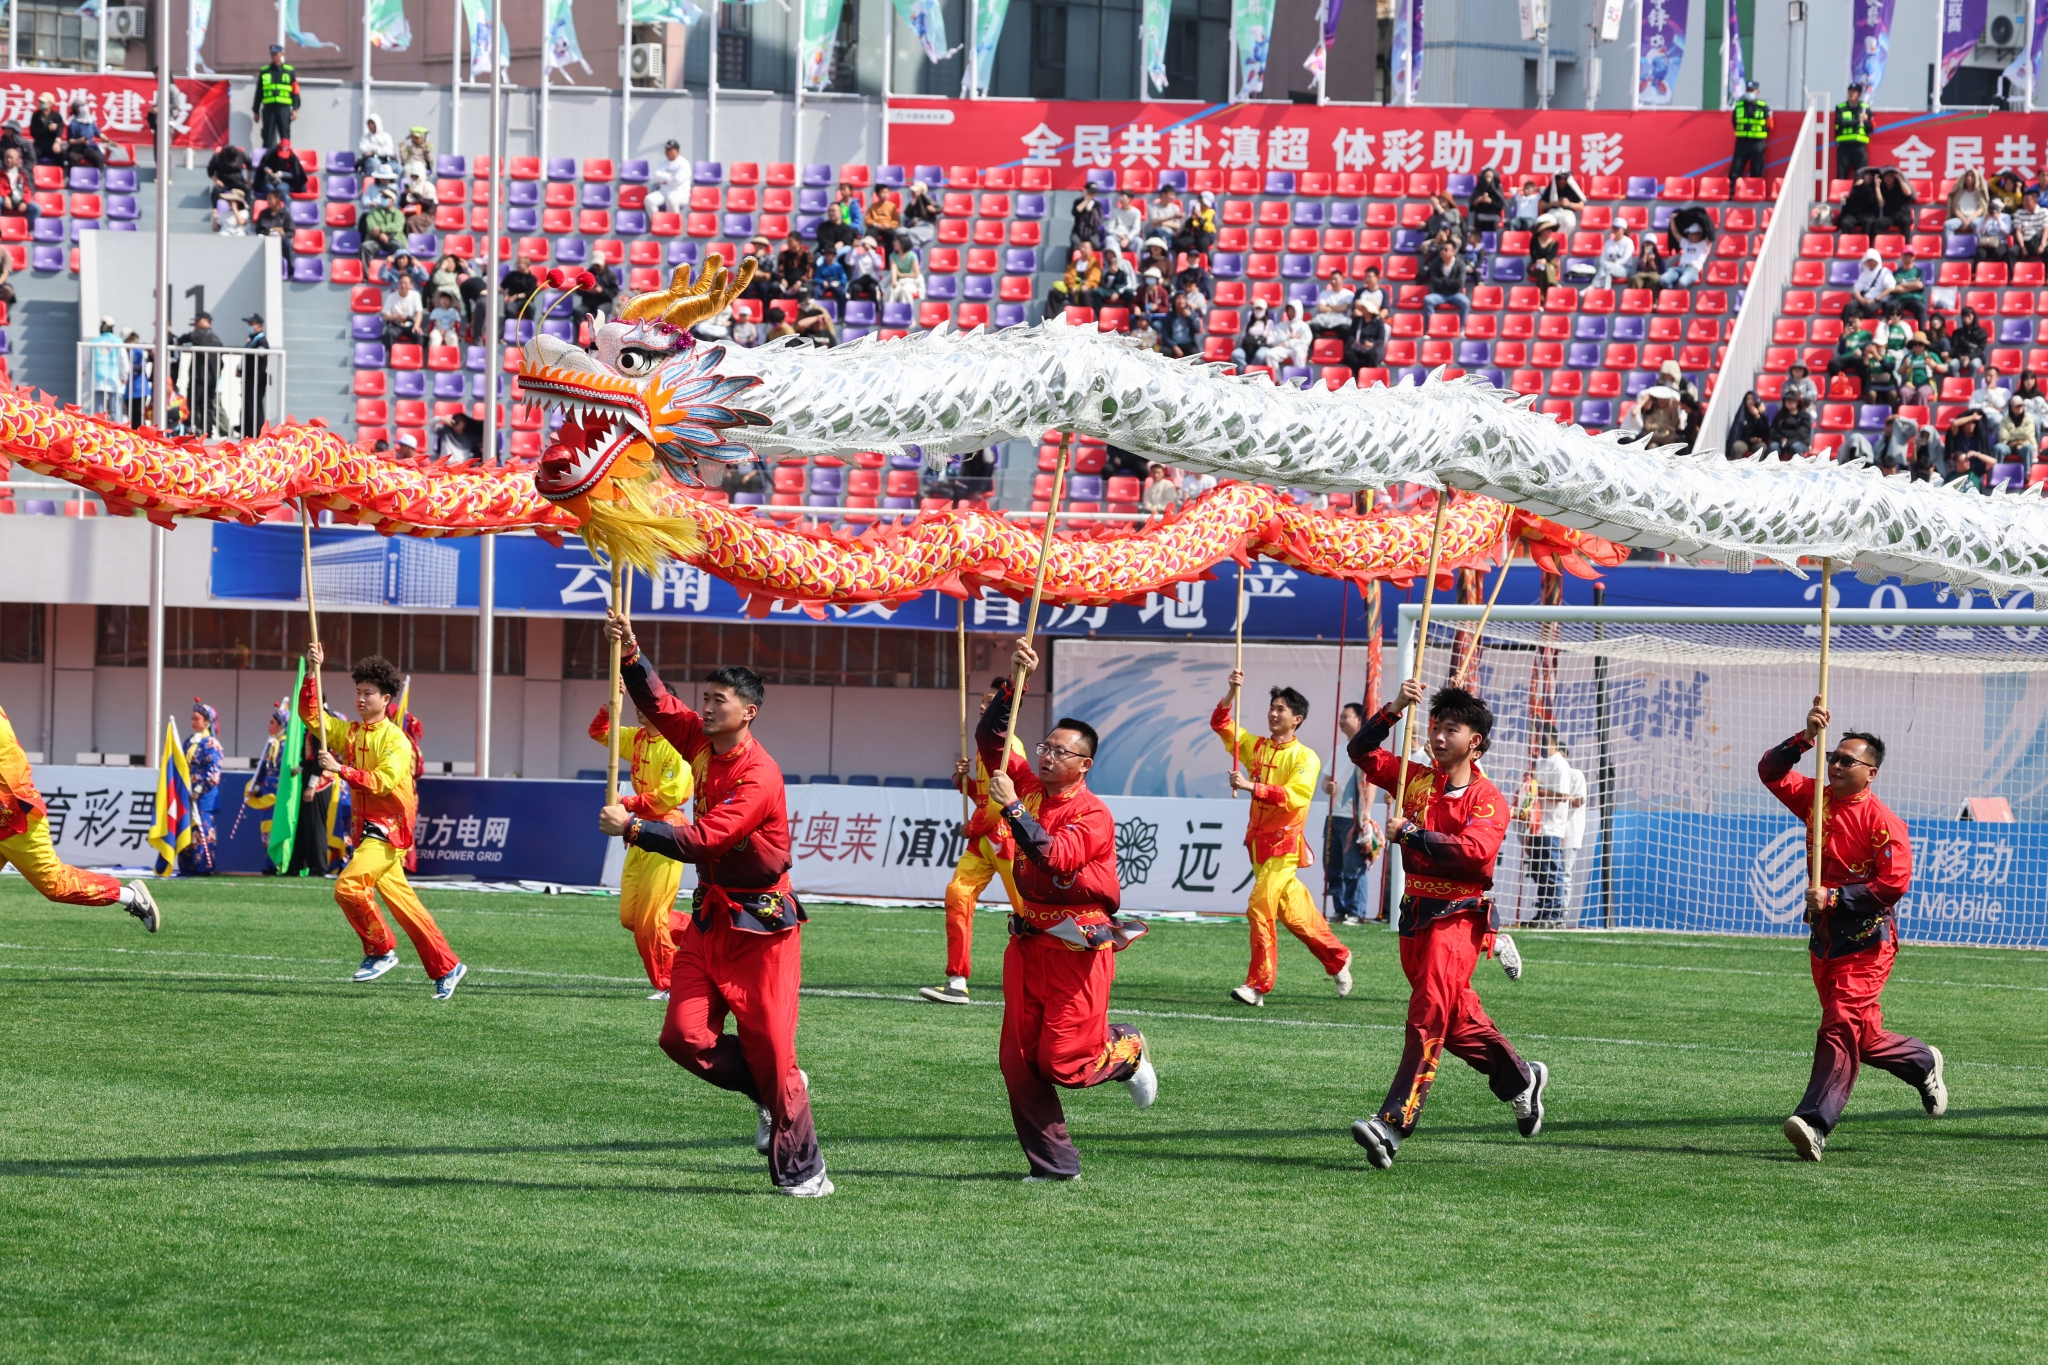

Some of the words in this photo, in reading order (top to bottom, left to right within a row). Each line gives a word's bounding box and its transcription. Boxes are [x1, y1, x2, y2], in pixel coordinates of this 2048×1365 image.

[1021, 122, 1310, 170] 全民共赴滇超
[1332, 127, 1624, 176] 体彩助力出彩
[1891, 134, 2048, 180] 全民共
[415, 814, 510, 848] 南方电网
[437, 849, 475, 861] POWER
[476, 851, 503, 862] GRID
[1171, 819, 1254, 894] 远
[1918, 891, 2003, 922] Mobile
